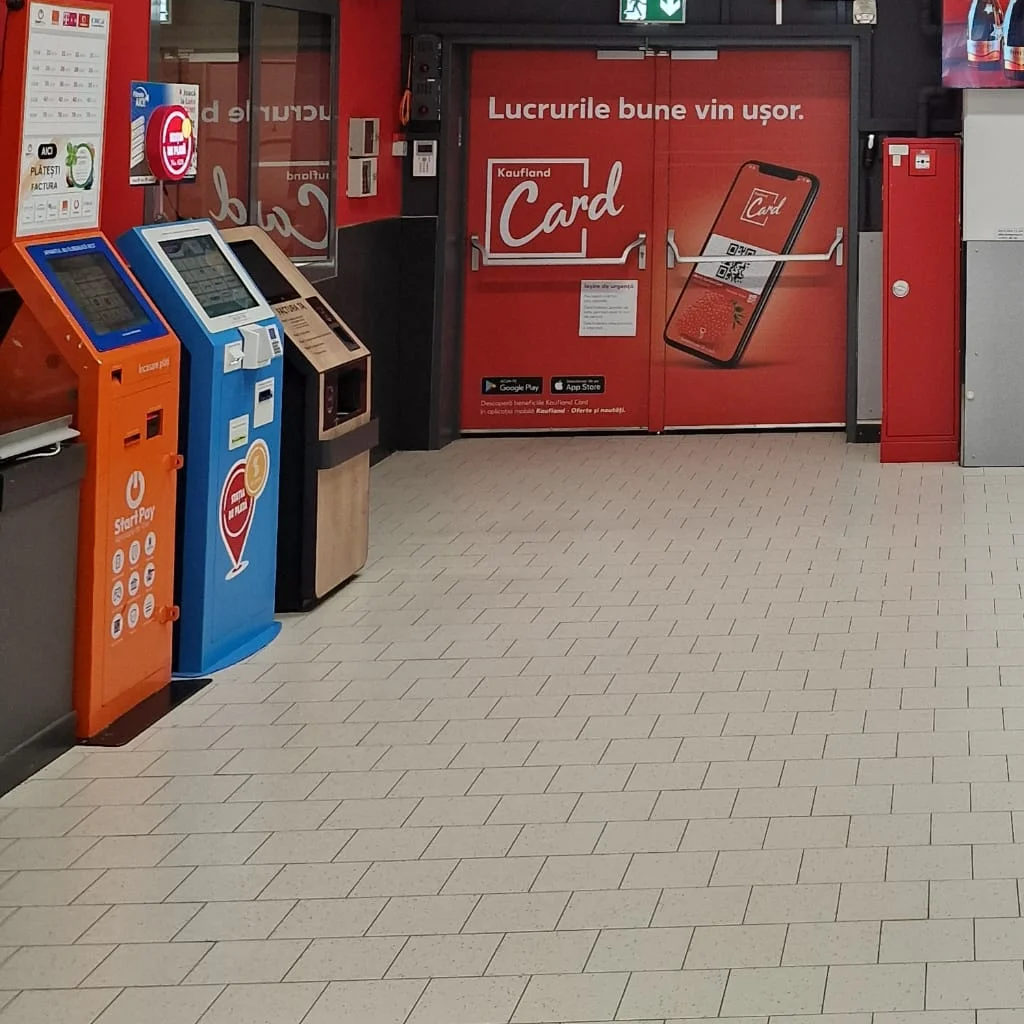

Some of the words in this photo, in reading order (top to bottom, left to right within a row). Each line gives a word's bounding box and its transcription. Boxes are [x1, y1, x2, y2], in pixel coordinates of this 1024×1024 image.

[488, 96, 611, 119] Lucrurile
[619, 97, 687, 120] bune
[695, 99, 734, 120] vin
[742, 103, 804, 126] ușor.
[41, 146, 53, 156] AICI
[498, 168, 551, 177] Kaufland
[31, 182, 57, 191] FACTURA
[500, 161, 624, 247] Card
[747, 197, 787, 218] Card
[500, 383, 524, 392] Google
[525, 383, 539, 392] Play
[566, 384, 581, 392] App
